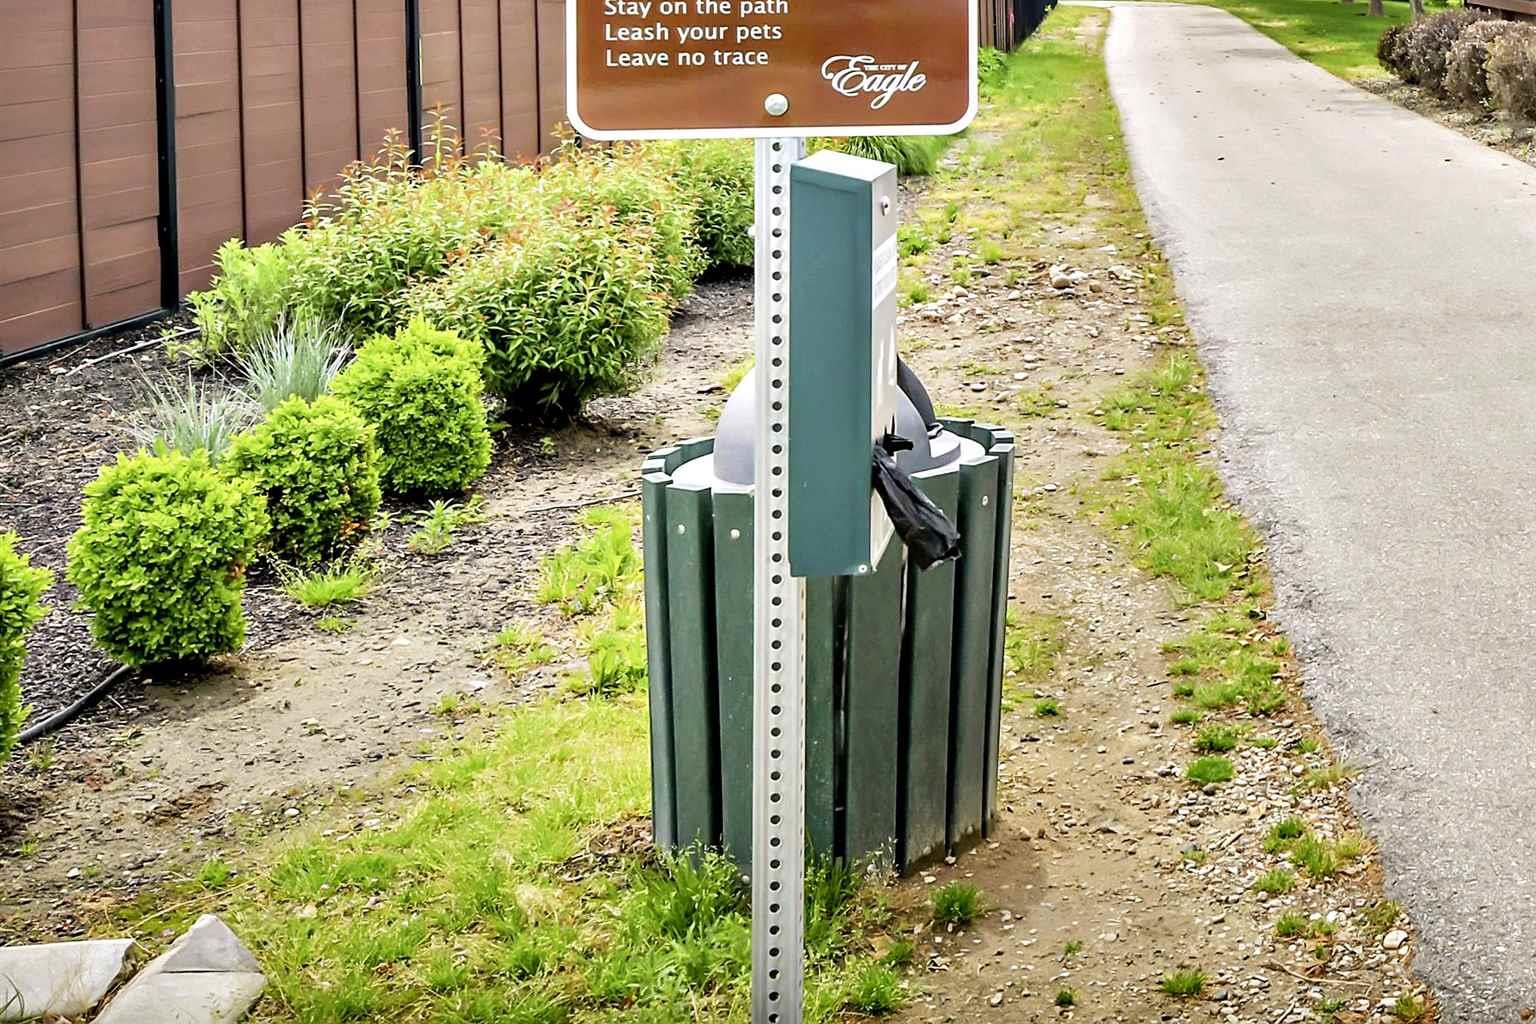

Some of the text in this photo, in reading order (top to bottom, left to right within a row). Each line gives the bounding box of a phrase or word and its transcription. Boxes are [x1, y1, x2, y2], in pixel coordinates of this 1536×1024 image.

[659, 1, 687, 15] on
[605, 22, 782, 44] Leash your pets
[606, 49, 768, 67] Leave no trace
[821, 55, 927, 110] Eagle
